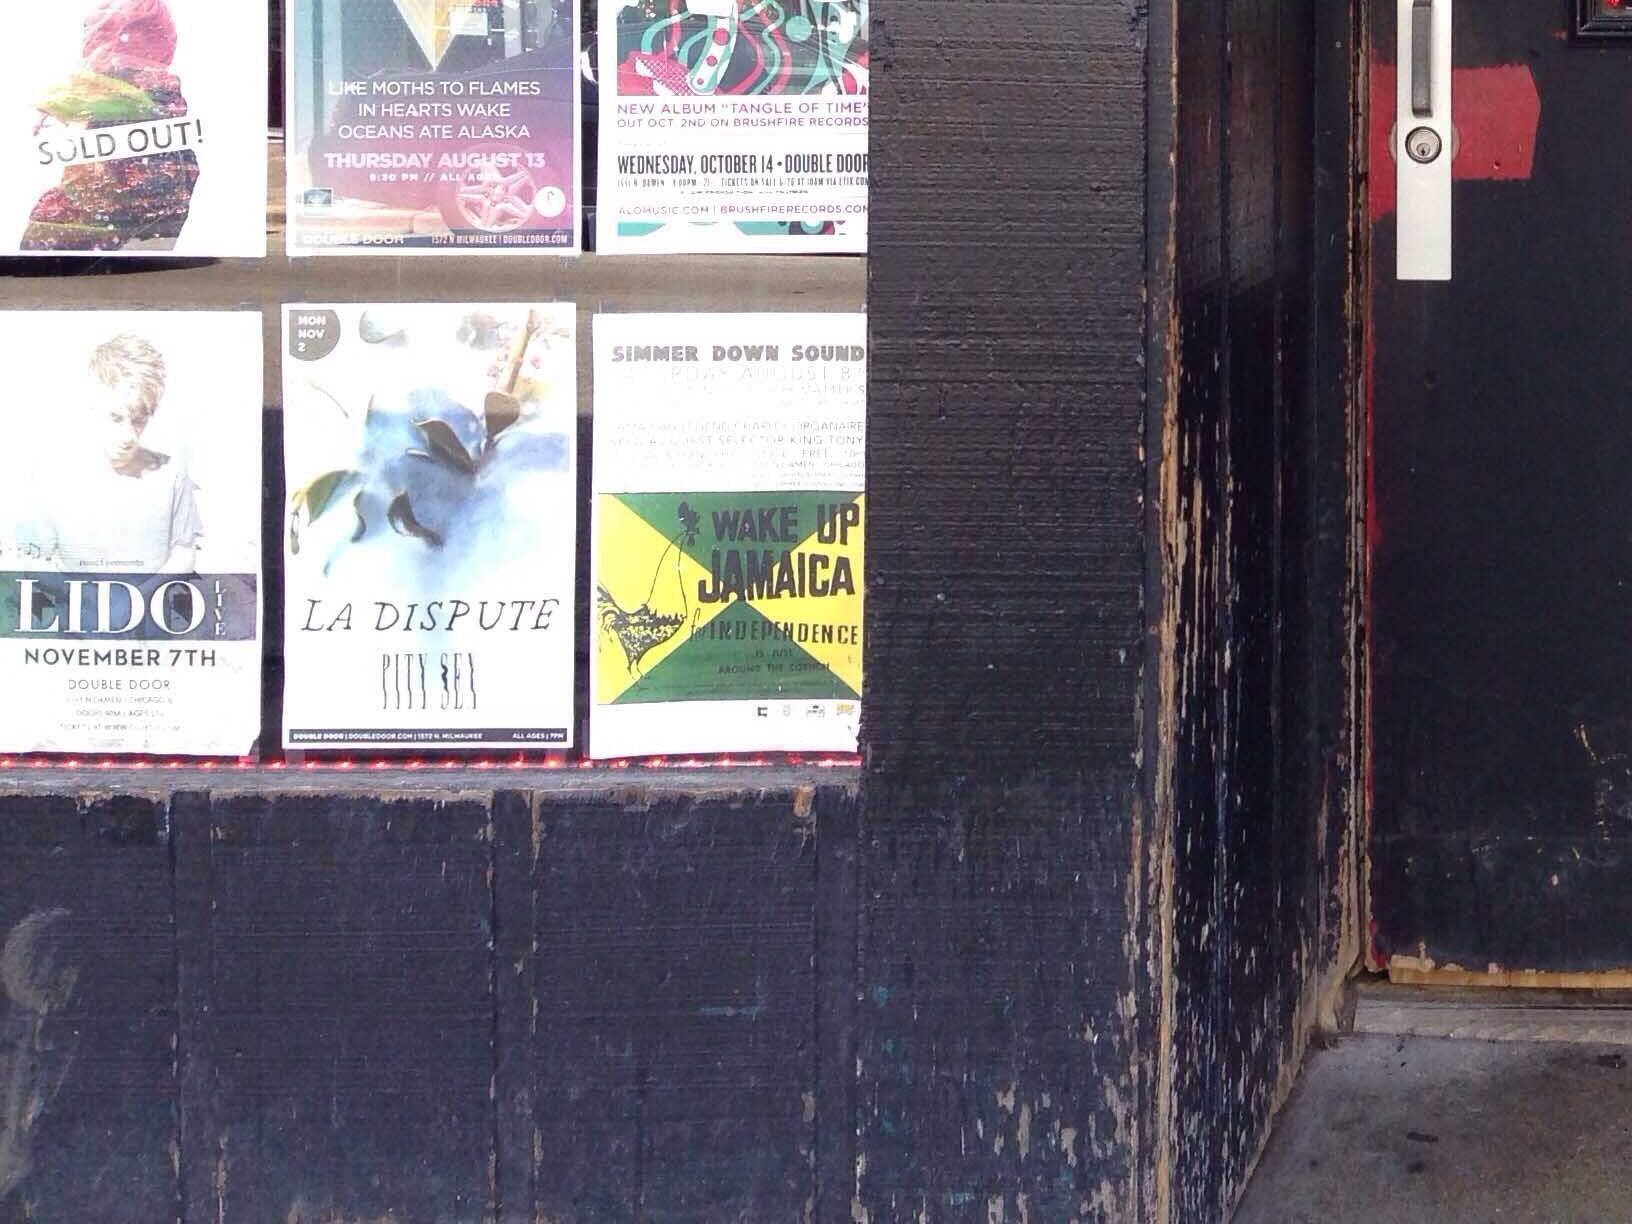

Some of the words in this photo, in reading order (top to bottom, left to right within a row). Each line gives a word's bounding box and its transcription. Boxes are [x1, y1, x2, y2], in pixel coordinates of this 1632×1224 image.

[328, 81, 367, 96] LIKE
[373, 81, 435, 96] MOTHS
[440, 81, 464, 96] TO
[469, 81, 541, 96] FLAMES
[358, 104, 375, 117] IN
[380, 104, 452, 117] HEARTS
[457, 104, 510, 117] WAKE
[617, 103, 655, 115] NEW
[661, 103, 716, 114] ALBUM
[721, 103, 792, 114] "TANGLE
[799, 103, 819, 114] OF
[617, 119, 644, 128] OUT
[648, 119, 673, 128] OCT
[681, 118, 706, 127] 2ND
[711, 118, 729, 127] ON
[733, 118, 804, 127] BRUSHFIRE
[809, 117, 868, 127] RECORDS
[339, 126, 415, 139] OCEANS
[420, 126, 453, 139] ATE
[457, 126, 530, 139] ALASKA
[38, 133, 116, 166] SOLD
[127, 119, 203, 154] OUT!
[324, 153, 433, 169] THURSDAY
[438, 153, 523, 169] AUGUST
[526, 153, 546, 169] 13
[617, 155, 697, 176] WEDNESDAY,
[700, 155, 757, 174] OCTOBER
[762, 155, 774, 174] 14
[785, 154, 832, 174] DOUBLE
[440, 173, 461, 182] ALL
[363, 233, 405, 245] DOOR
[457, 235, 497, 244] MILWAUKEE
[503, 235, 568, 245] DOUBLEDOOR.COM
[298, 315, 326, 325] MON
[298, 328, 325, 339] NOV
[298, 342, 306, 352] 2
[611, 345, 699, 362] SIMMER
[712, 345, 779, 362] DOWN
[791, 345, 865, 362] SOUND
[712, 507, 798, 543] WAKE
[816, 502, 860, 546] UP
[697, 550, 856, 604] JAMAICA
[15, 579, 206, 635] LIDO
[214, 580, 226, 636] LIVE
[301, 599, 352, 631] LA
[374, 598, 560, 631] DISPUTE
[711, 621, 859, 645] INDEPENDENCE
[25, 648, 161, 667] NOVEMBER
[170, 649, 216, 667] 7TH
[69, 680, 122, 690] DOUBLE
[129, 680, 171, 690] DOOR
[382, 653, 427, 710] PITY
